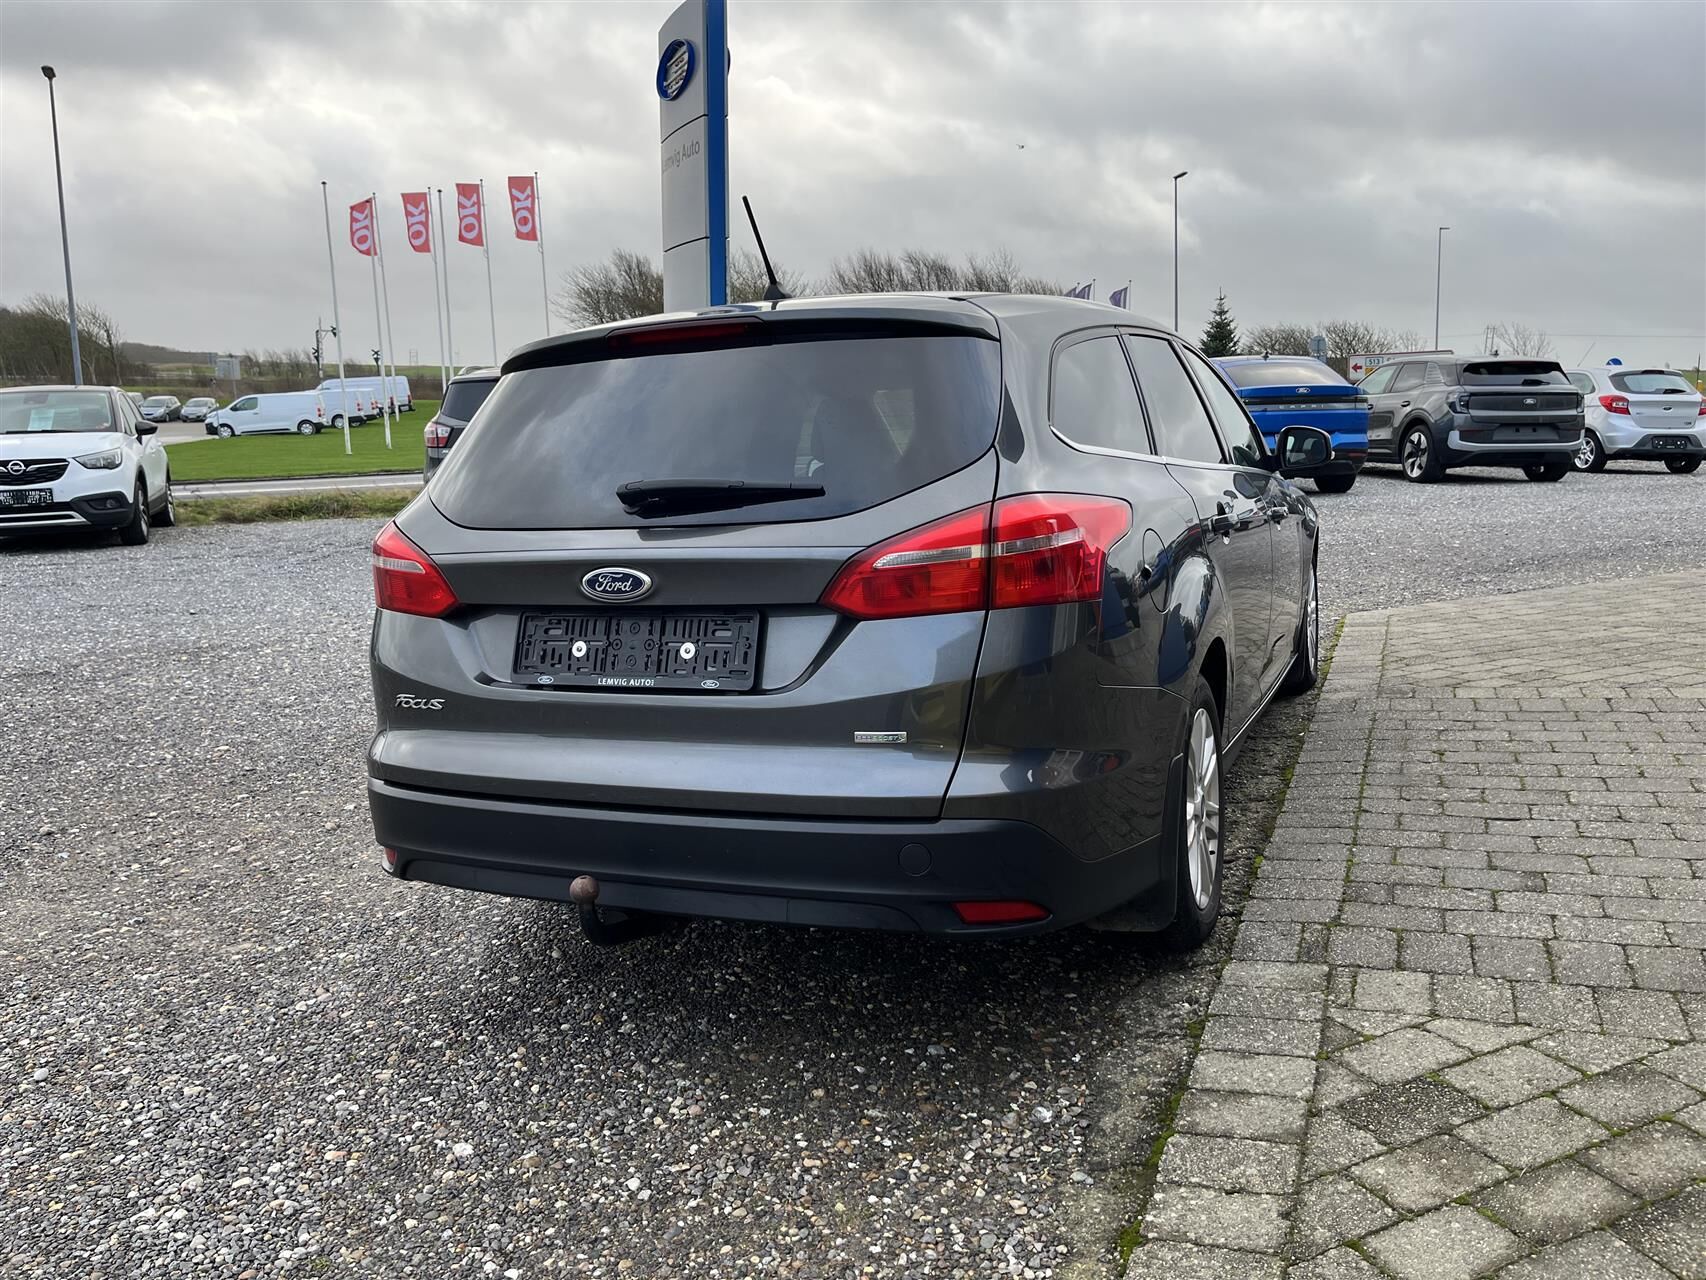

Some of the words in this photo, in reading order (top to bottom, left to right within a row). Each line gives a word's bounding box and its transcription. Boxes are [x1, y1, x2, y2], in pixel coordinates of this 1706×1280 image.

[680, 139, 700, 161] Auto
[406, 201, 427, 247] OK
[458, 193, 480, 240] OK
[511, 185, 533, 234] OK
[353, 207, 372, 251] OK
[1368, 358, 1381, 366] 513
[595, 572, 633, 592] Ford
[597, 677, 627, 686] LEMVIG
[628, 678, 651, 687] AUTO
